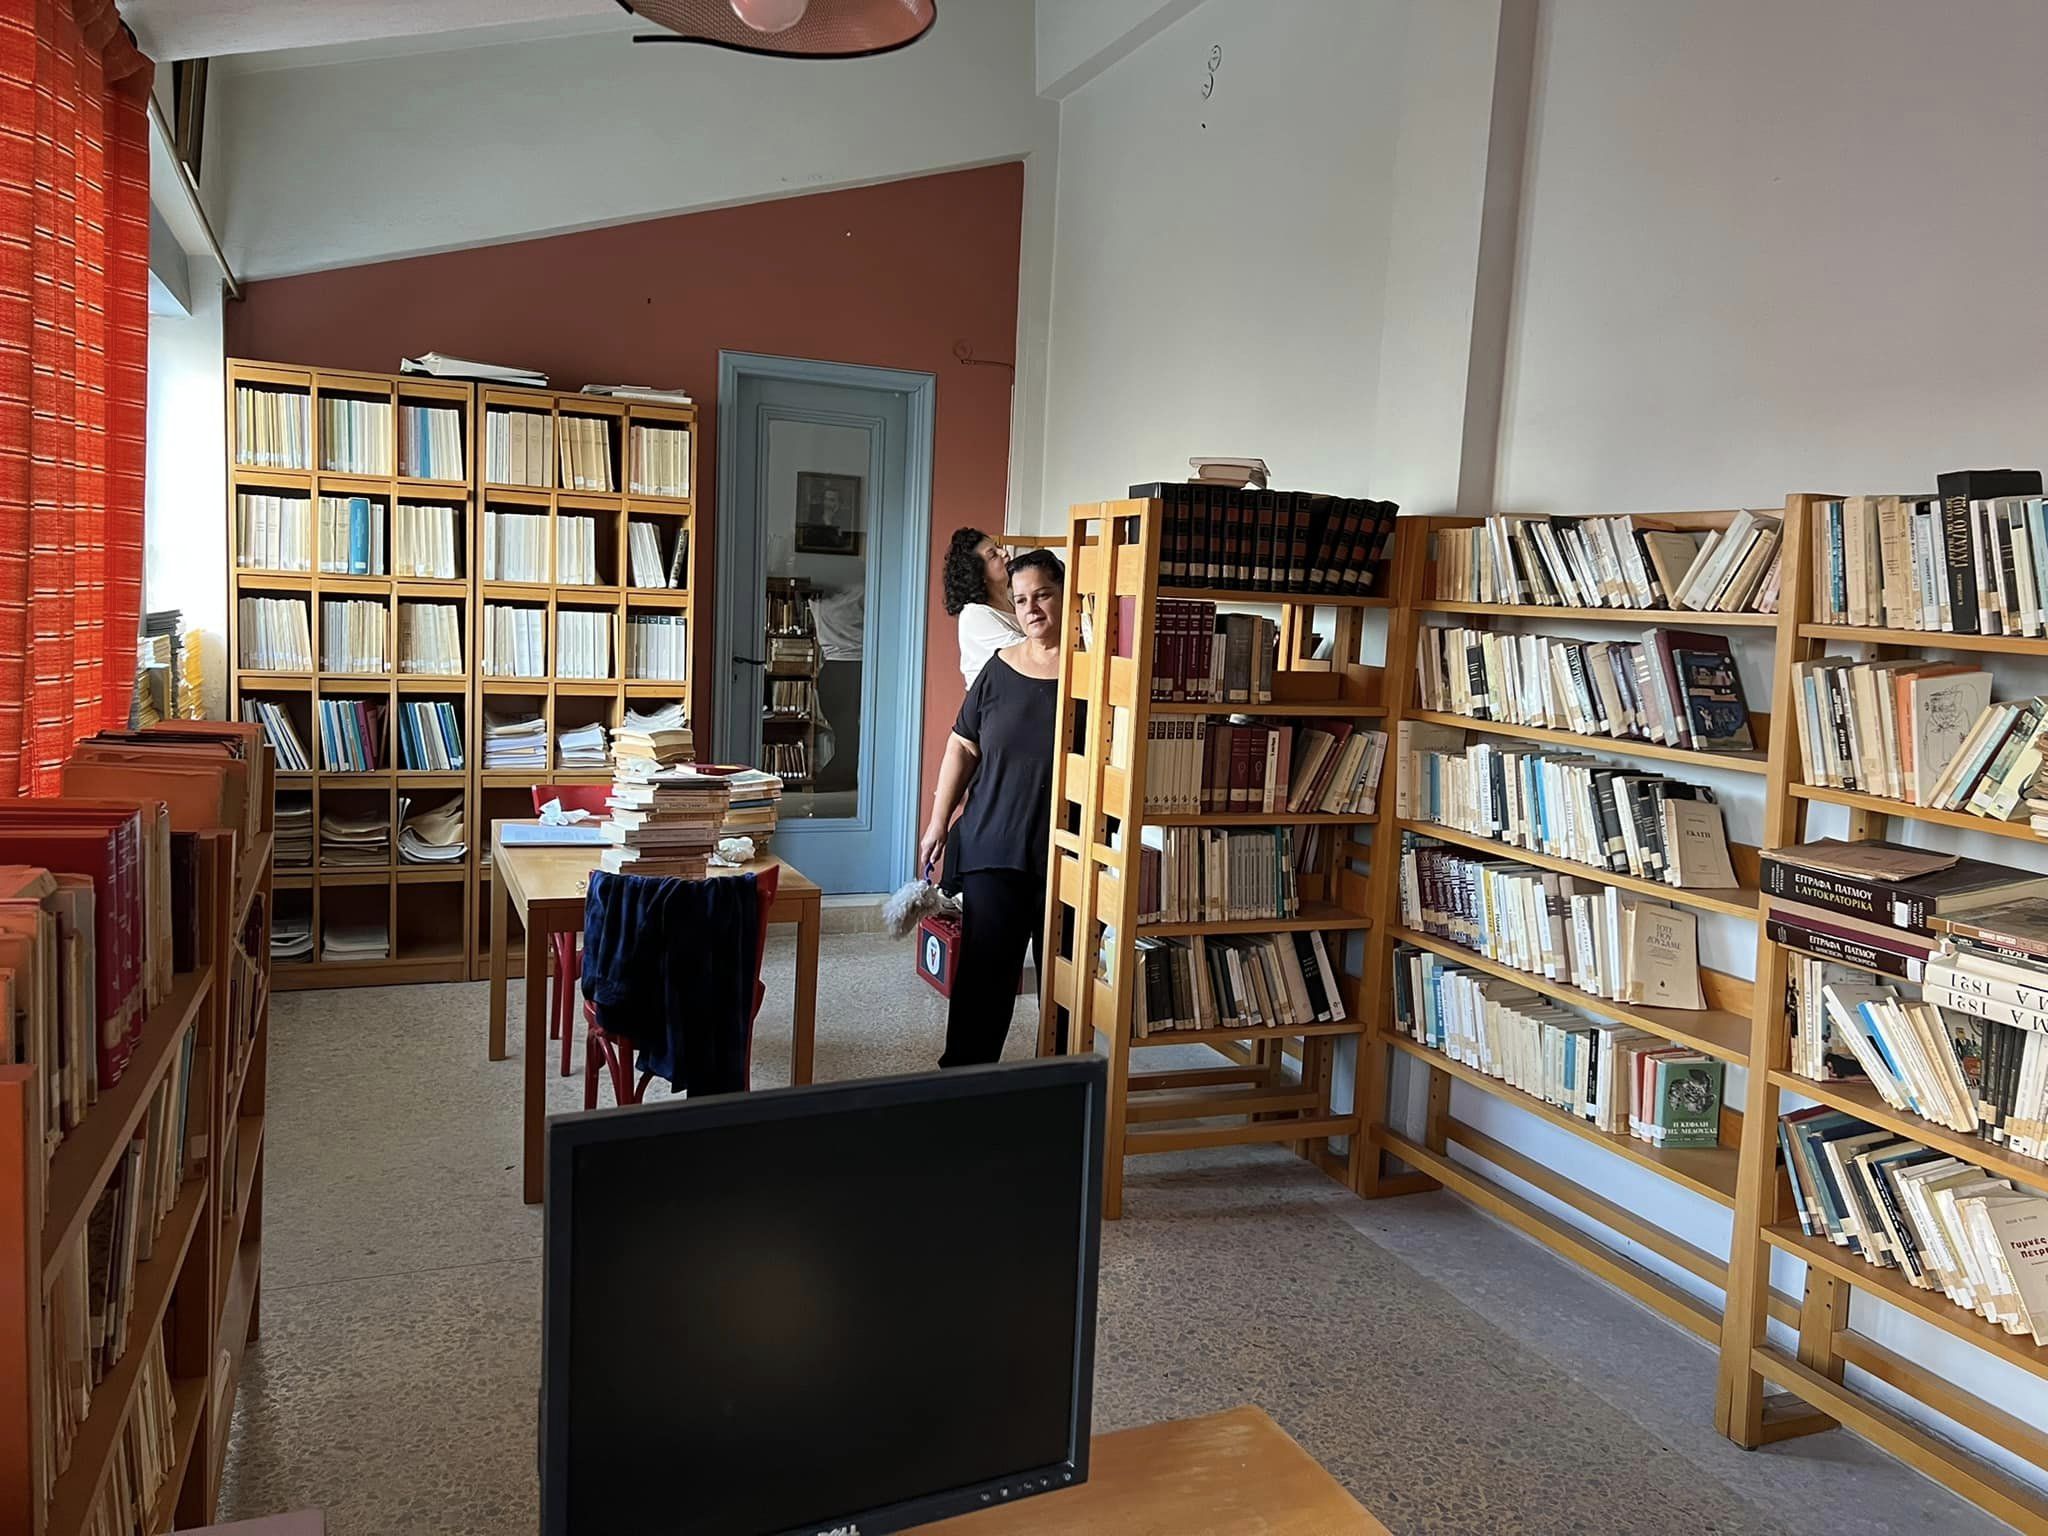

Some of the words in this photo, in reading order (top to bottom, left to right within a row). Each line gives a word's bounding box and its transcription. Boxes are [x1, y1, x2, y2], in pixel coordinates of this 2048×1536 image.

[1794, 873, 1832, 890] ΕΓΓΡΑΦΑ
[1834, 883, 1873, 901] ΠΑΤΜΟΥ
[1801, 886, 1873, 912] ΑΥΤΟΚΡΑΤΟΡΙΚΑ
[1844, 944, 1877, 960] ΠΑΤΜΟΥ
[1951, 973, 1991, 996] 1821
[1948, 992, 1988, 1016] 1821
